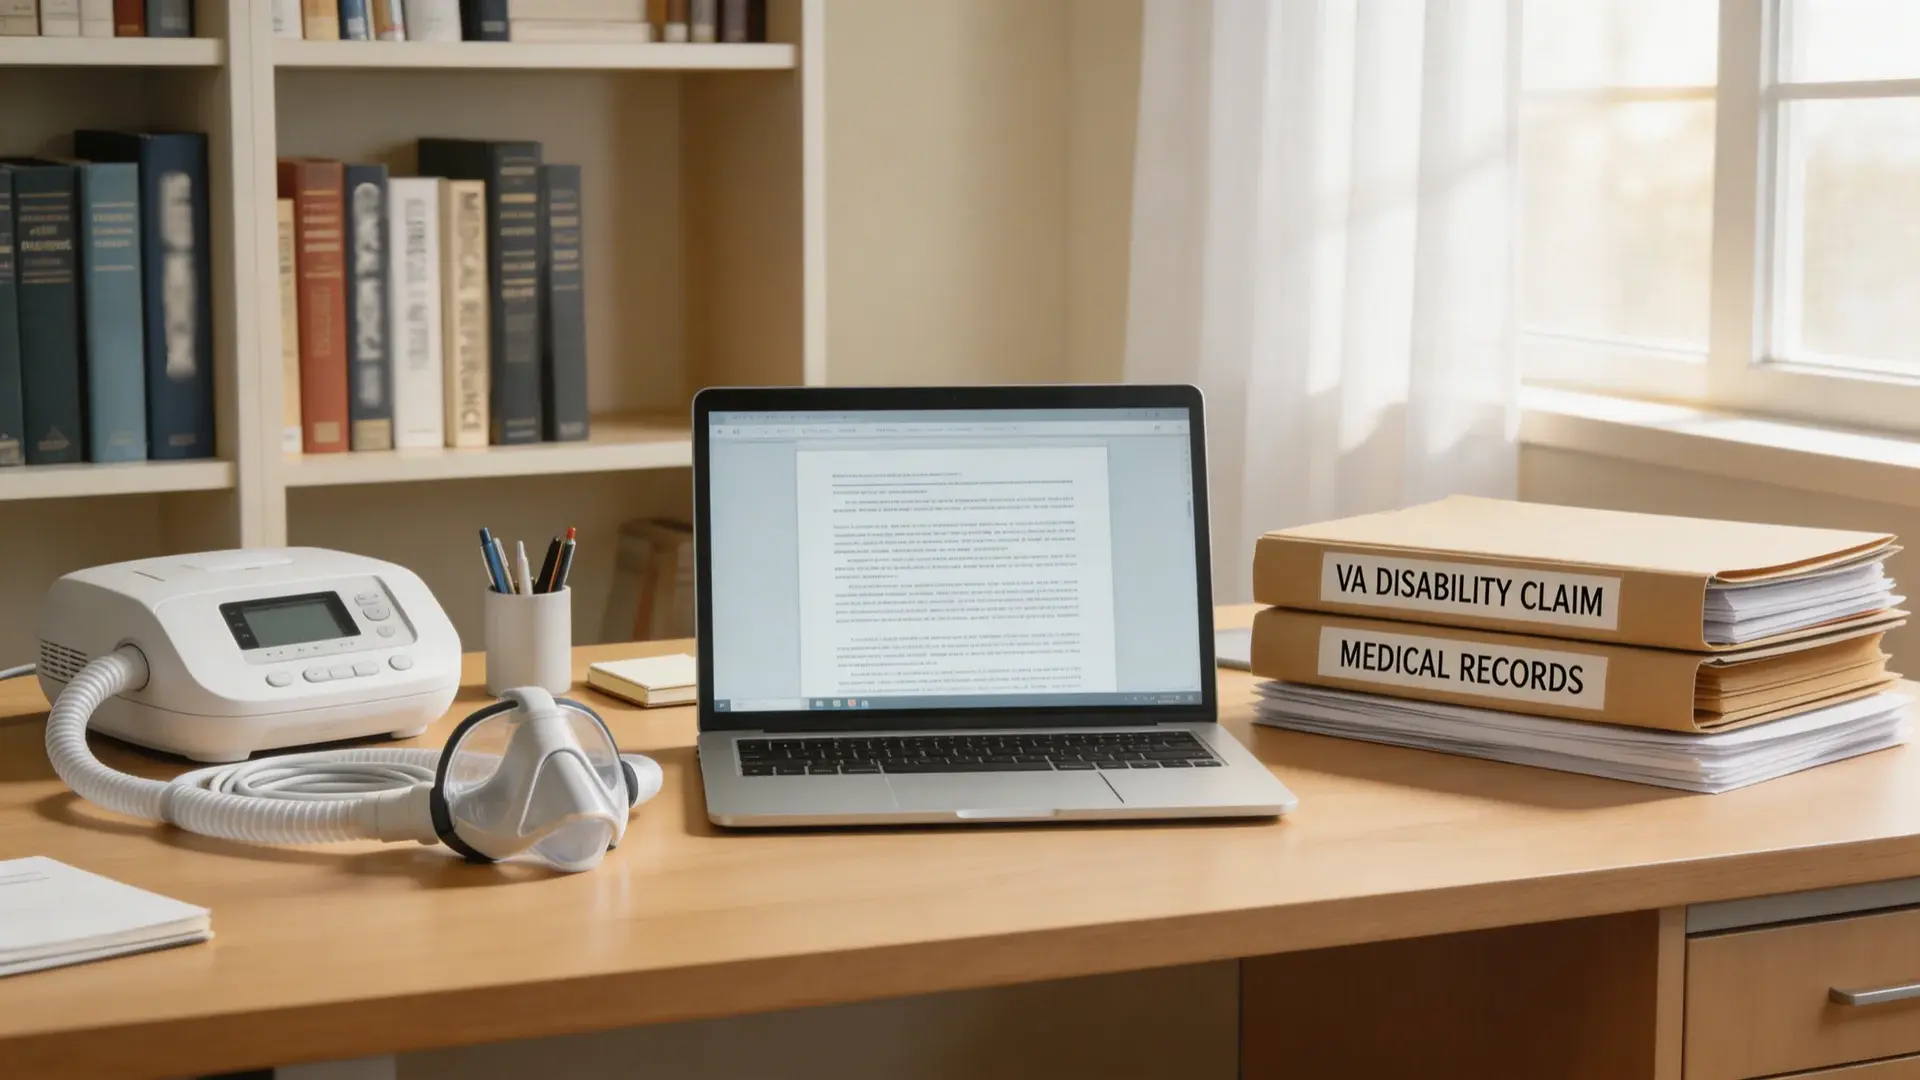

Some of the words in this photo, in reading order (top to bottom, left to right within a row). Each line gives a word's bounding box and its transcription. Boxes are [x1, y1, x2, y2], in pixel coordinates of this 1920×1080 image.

[1337, 563, 1368, 594] VA
[1376, 566, 1512, 607] DISABILITY
[1520, 580, 1604, 618] CLAIM
[1340, 639, 1451, 680] MEDICAL
[1459, 652, 1584, 695] RECORDS
